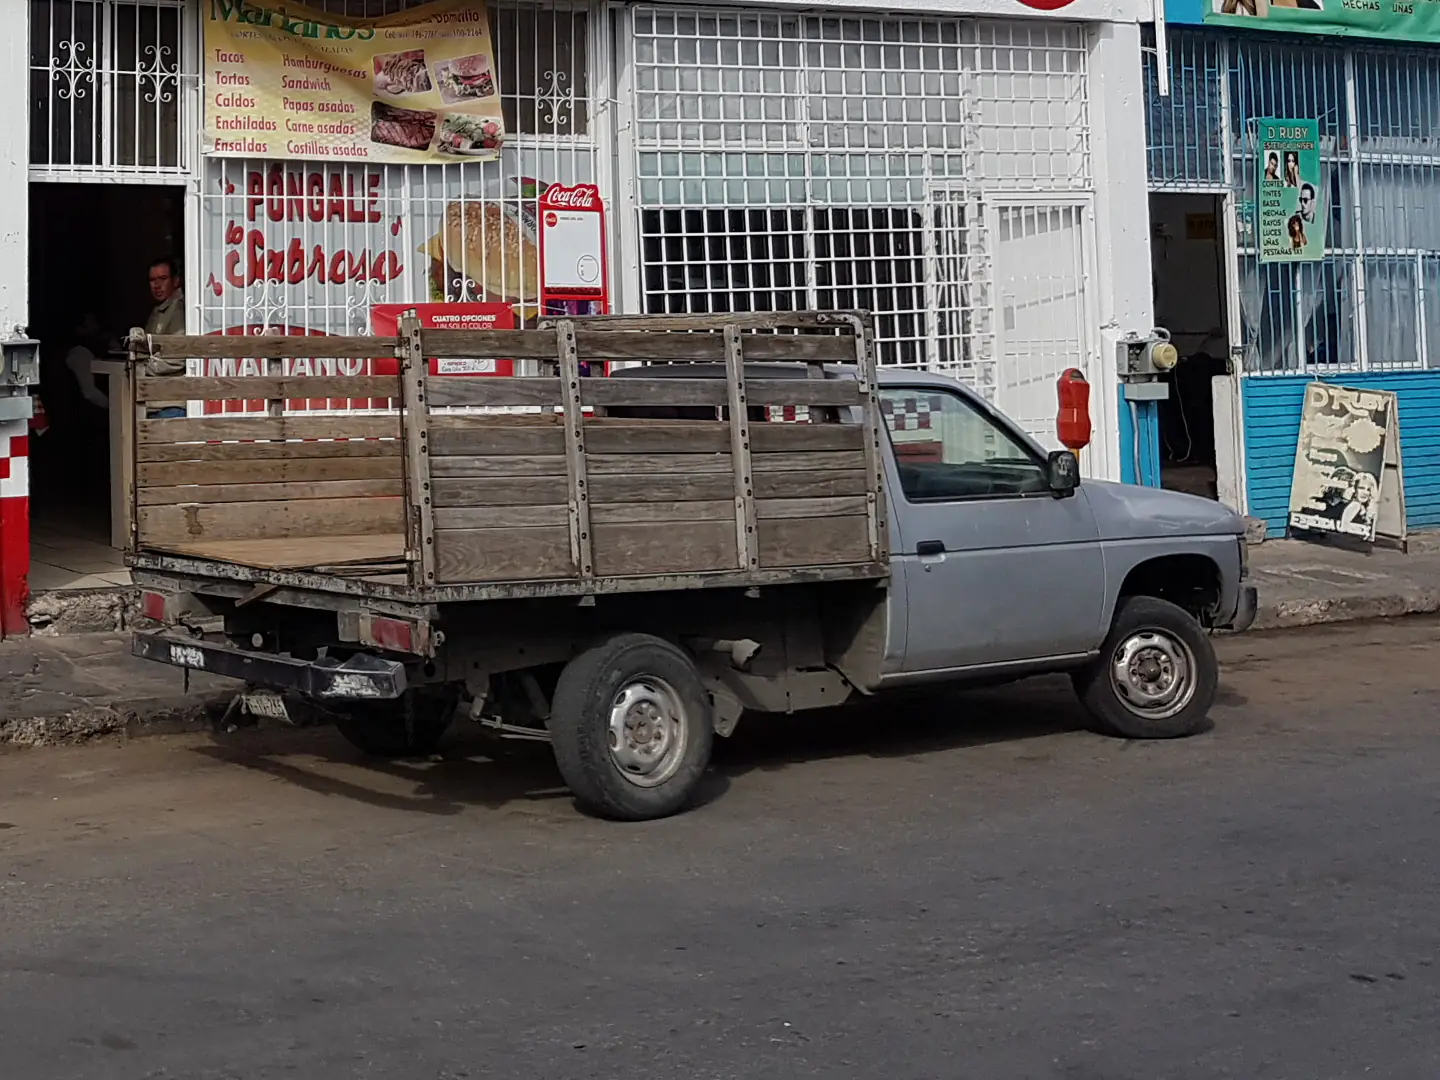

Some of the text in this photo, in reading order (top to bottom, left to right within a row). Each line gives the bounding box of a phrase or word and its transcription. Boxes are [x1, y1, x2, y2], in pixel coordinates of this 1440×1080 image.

[1342, 0, 1380, 10] MECHAS
[1392, 2, 1413, 14] UÑAS
[215, 49, 245, 64] Tacos
[282, 53, 368, 80] Hamburguesas
[215, 71, 250, 86] Tortas
[282, 76, 331, 92] Sandwich
[215, 93, 255, 108] Caldos
[282, 97, 355, 114] Papas asadas
[215, 116, 277, 131] Enchiladas
[285, 120, 355, 135] Carne asadas
[1280, 127, 1308, 139] RUBY
[214, 138, 268, 153] Ensaldas
[287, 140, 368, 157] Costillas asadas
[1262, 180, 1284, 188] CORTES
[247, 163, 381, 223] PÓNGALE
[547, 186, 594, 207] Coca-Cola
[1263, 190, 1281, 198] TINTES
[1263, 199, 1280, 207] BASES
[1263, 209, 1286, 217] MECHAS
[1263, 219, 1281, 227] RAYOS
[1263, 229, 1281, 237] LUCES
[1263, 237, 1279, 246] UÑAS
[225, 228, 404, 288] Sabroso
[1263, 247, 1292, 256] PESTAÑAS
[461, 314, 496, 322] OPCIONES
